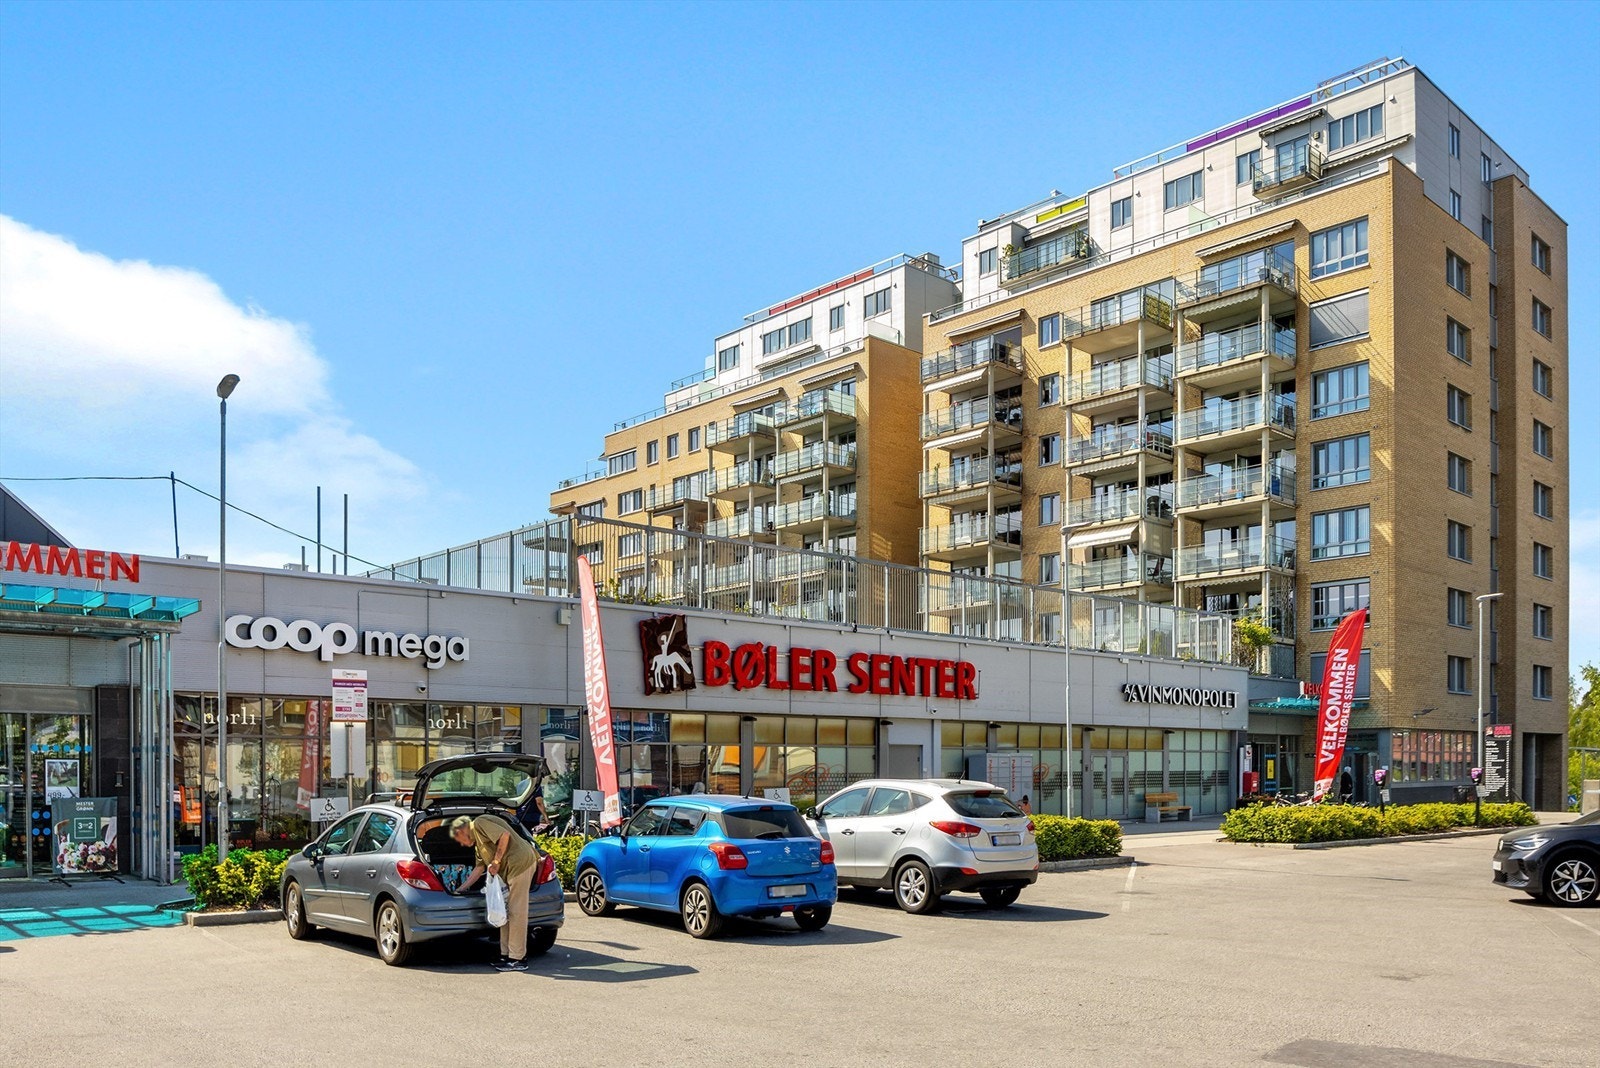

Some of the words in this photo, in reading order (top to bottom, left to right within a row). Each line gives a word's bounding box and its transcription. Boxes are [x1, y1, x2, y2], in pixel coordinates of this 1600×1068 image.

[0, 541, 140, 583] MMEN
[224, 614, 358, 662] coop
[364, 630, 470, 669] mega
[704, 641, 838, 692] BØLER
[848, 652, 977, 700] SENTER
[1345, 664, 1356, 700] SENTER
[1137, 684, 1240, 709] VINMONOPOLET
[1320, 648, 1349, 764] VELKOMMEN
[203, 706, 257, 725] nrli
[1339, 701, 1352, 733] BØLER
[1337, 734, 1347, 748] TIL
